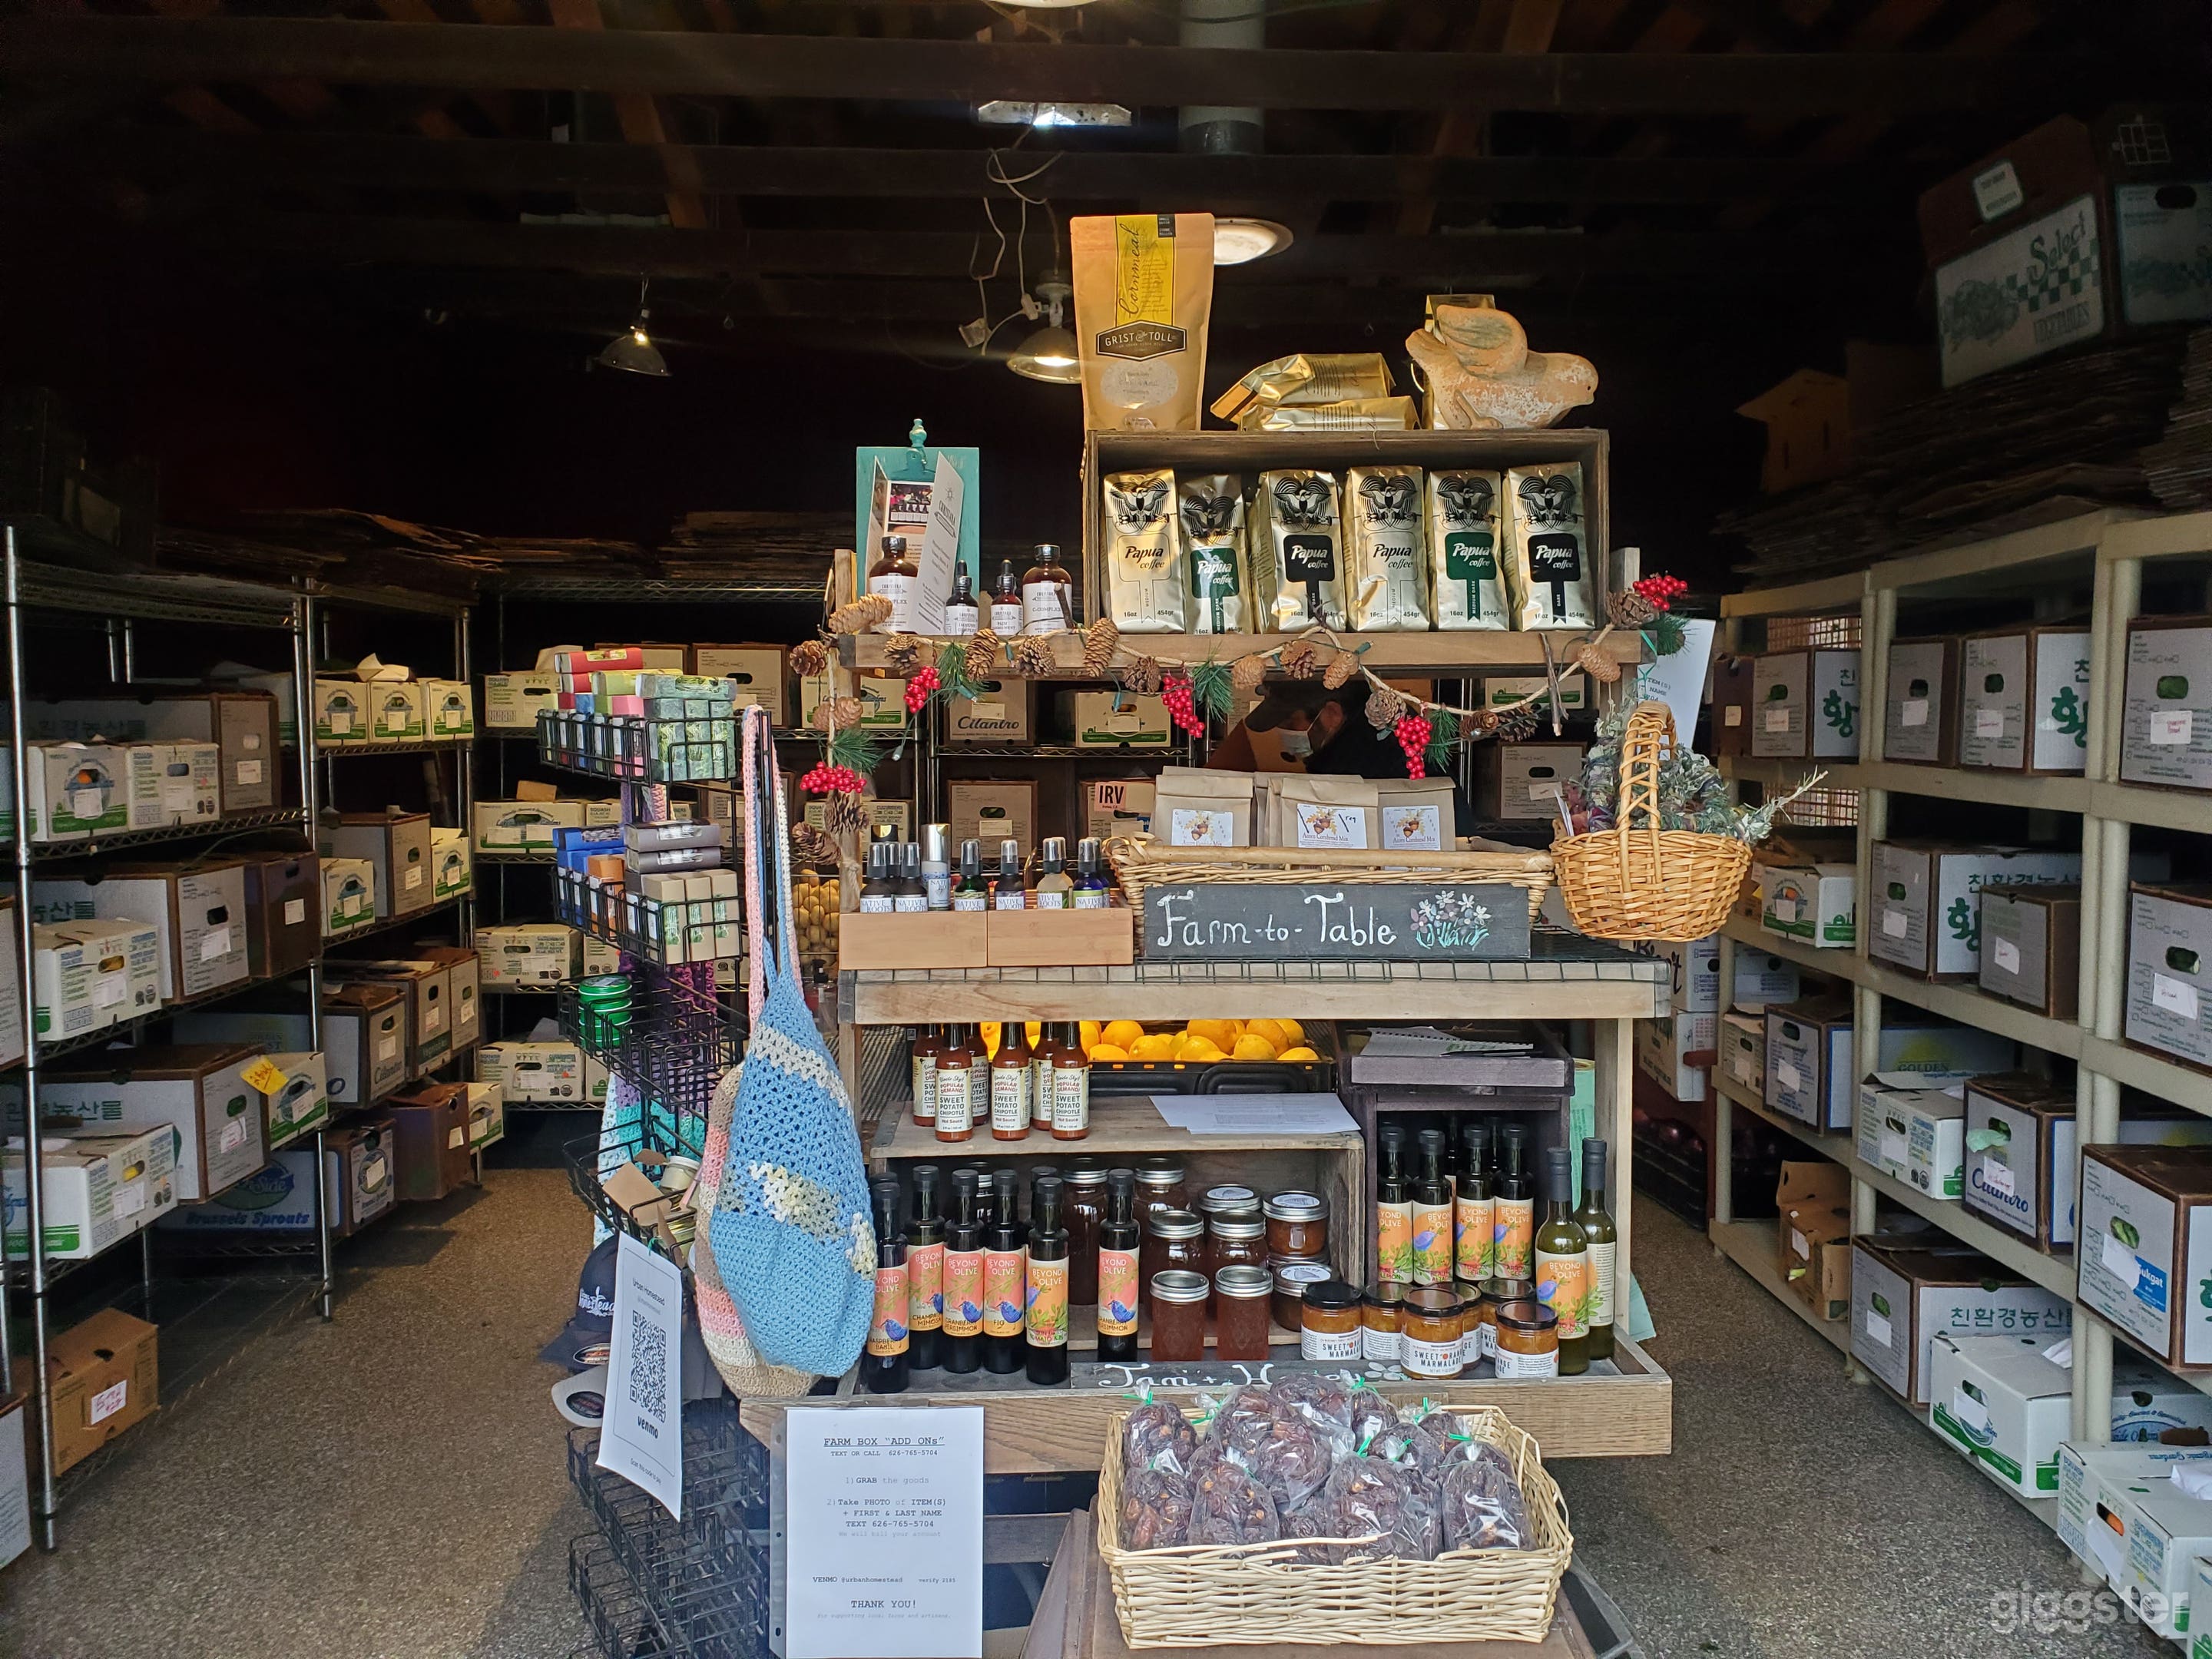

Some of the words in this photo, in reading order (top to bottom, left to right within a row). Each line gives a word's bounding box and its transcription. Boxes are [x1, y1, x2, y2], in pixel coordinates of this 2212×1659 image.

[2028, 209, 2087, 285] Select
[1119, 223, 1141, 319] Cornmeal
[1104, 332, 1134, 346] GRIST
[1148, 331, 1173, 343] TOLL
[1124, 546, 1164, 563] Papua
[1291, 545, 1328, 565] Papua
[1373, 544, 1412, 562] Papua
[1452, 543, 1490, 562] Papua
[1535, 545, 1574, 564] Papua
[1139, 560, 1165, 570] coffee
[1307, 559, 1329, 569] coffee
[1387, 558, 1413, 570] coffee
[1469, 558, 1491, 568] coffee
[1552, 559, 1574, 569] coffee
[1197, 561, 1233, 578] Papua
[1212, 576, 1233, 585] coffee
[957, 716, 1020, 730] Cilantro
[1098, 785, 1124, 805] IRV
[1316, 833, 1338, 842] Cornbread
[1899, 1060, 1950, 1073] GOLDEN
[1380, 1211, 1402, 1220] YOND
[1459, 1207, 1488, 1216] BEYOND
[1501, 1207, 1530, 1215] BEYOND
[187, 1211, 247, 1225] Brussels
[252, 1211, 310, 1227] Sprouts
[1508, 1215, 1530, 1224] OLIVE
[922, 1260, 942, 1270] OLIV
[948, 1259, 978, 1267] BEYOND
[986, 1258, 1015, 1267] BEYOND
[1549, 1262, 1581, 1270] BEYOND
[992, 1267, 1015, 1276] OLIVE
[1032, 1268, 1062, 1277] BEYOND
[1104, 1266, 1127, 1275] OLIVE
[1557, 1270, 1581, 1279] OLIVE
[876, 1275, 899, 1284] YOND
[1038, 1277, 1062, 1286] OLIVE
[944, 1323, 978, 1332] PERSIMMON
[993, 1320, 1005, 1329] FIG
[1322, 1343, 1346, 1352] SWEET
[1329, 1346, 1361, 1358] MARMALA
[1414, 1350, 1439, 1360] SWEET
[1098, 1363, 1198, 1389] Jam
[637, 1416, 659, 1439] venmo
[823, 1438, 851, 1446] FARM
[850, 1600, 885, 1608] THANK
[891, 1599, 916, 1608] YOU!
